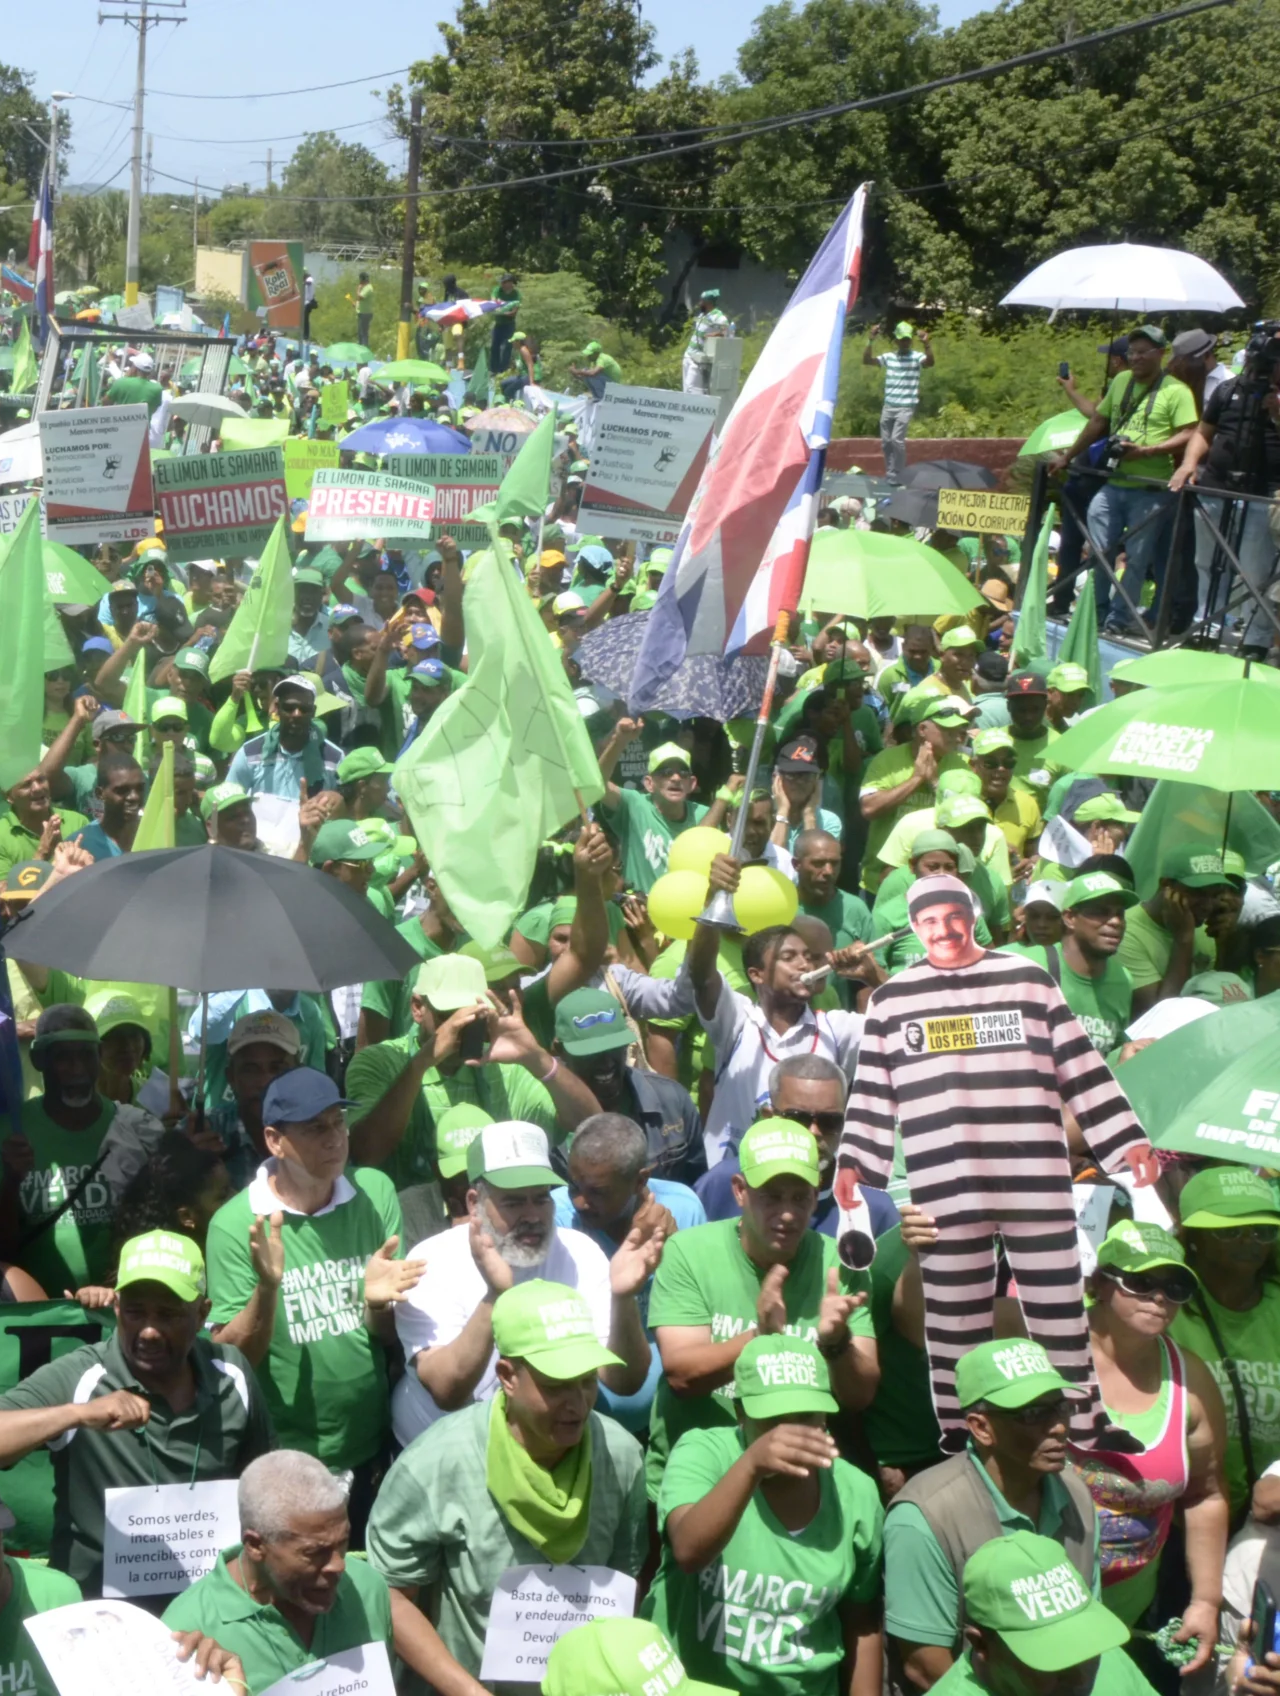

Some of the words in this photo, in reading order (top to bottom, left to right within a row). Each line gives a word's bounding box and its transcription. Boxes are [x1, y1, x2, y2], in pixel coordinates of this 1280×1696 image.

[264, 270, 287, 287] Kola
[268, 280, 289, 297] Real
[638, 398, 667, 409] LIMON
[667, 402, 679, 410] DE
[680, 404, 717, 416] SAMANA
[72, 418, 98, 427] LIMON
[100, 416, 112, 424] DE
[112, 413, 147, 423] SAMANA
[601, 423, 649, 437] LUCHAMOS
[651, 429, 673, 439] POR:
[44, 444, 90, 454] LUCHAMOS
[484, 431, 517, 453] NO
[158, 464, 171, 485] EL
[172, 460, 208, 483] LIMON
[212, 457, 227, 478] DE
[228, 451, 278, 477] SAMANA
[392, 458, 403, 478] EL
[405, 458, 438, 478] LIMON
[440, 458, 452, 478] DE
[454, 458, 498, 478] SAMANA
[600, 459, 634, 470] Justicia
[316, 471, 327, 484] EL
[331, 472, 366, 485] LIMON
[368, 473, 380, 486] DE
[384, 478, 431, 496] SAMANA
[598, 471, 613, 481] Paz
[621, 472, 633, 482] No
[76, 486, 87, 494] No
[940, 490, 958, 505] POR
[959, 492, 987, 509] MEJOR
[161, 484, 286, 530] LUCHAMOS
[310, 488, 432, 519] PRESENTE
[371, 516, 384, 528] NO
[386, 517, 404, 529] HAY
[407, 519, 425, 530] PAZ
[124, 528, 148, 539] LDS
[1123, 721, 1215, 743] #MARCHA
[1117, 733, 1206, 760] FINDELA
[1108, 752, 1199, 772] IMPUNIDAD
[927, 1017, 980, 1034] MOVIMIENTO
[982, 1013, 1020, 1029] POPULAR
[930, 1034, 950, 1049] LOS
[953, 1028, 1022, 1048] PEREGRINOS
[1196, 1122, 1280, 1153] IMPUN
[757, 1350, 817, 1367] #MARCHA
[757, 1363, 820, 1387] VERDE
[128, 1512, 172, 1528] Somos
[174, 1508, 220, 1525] verdes,
[130, 1526, 204, 1545] incansables
[206, 1527, 215, 1539] e
[114, 1548, 187, 1565] invencibles
[128, 1570, 140, 1583] la
[1010, 1562, 1073, 1597] #MARCHA
[510, 1589, 543, 1604] Basta
[546, 1590, 561, 1604] de
[562, 1592, 617, 1608] robarnos
[515, 1612, 523, 1623] y
[525, 1608, 595, 1623] endeudarno
[515, 1655, 523, 1665] o
[327, 1678, 369, 1696] rebaño
